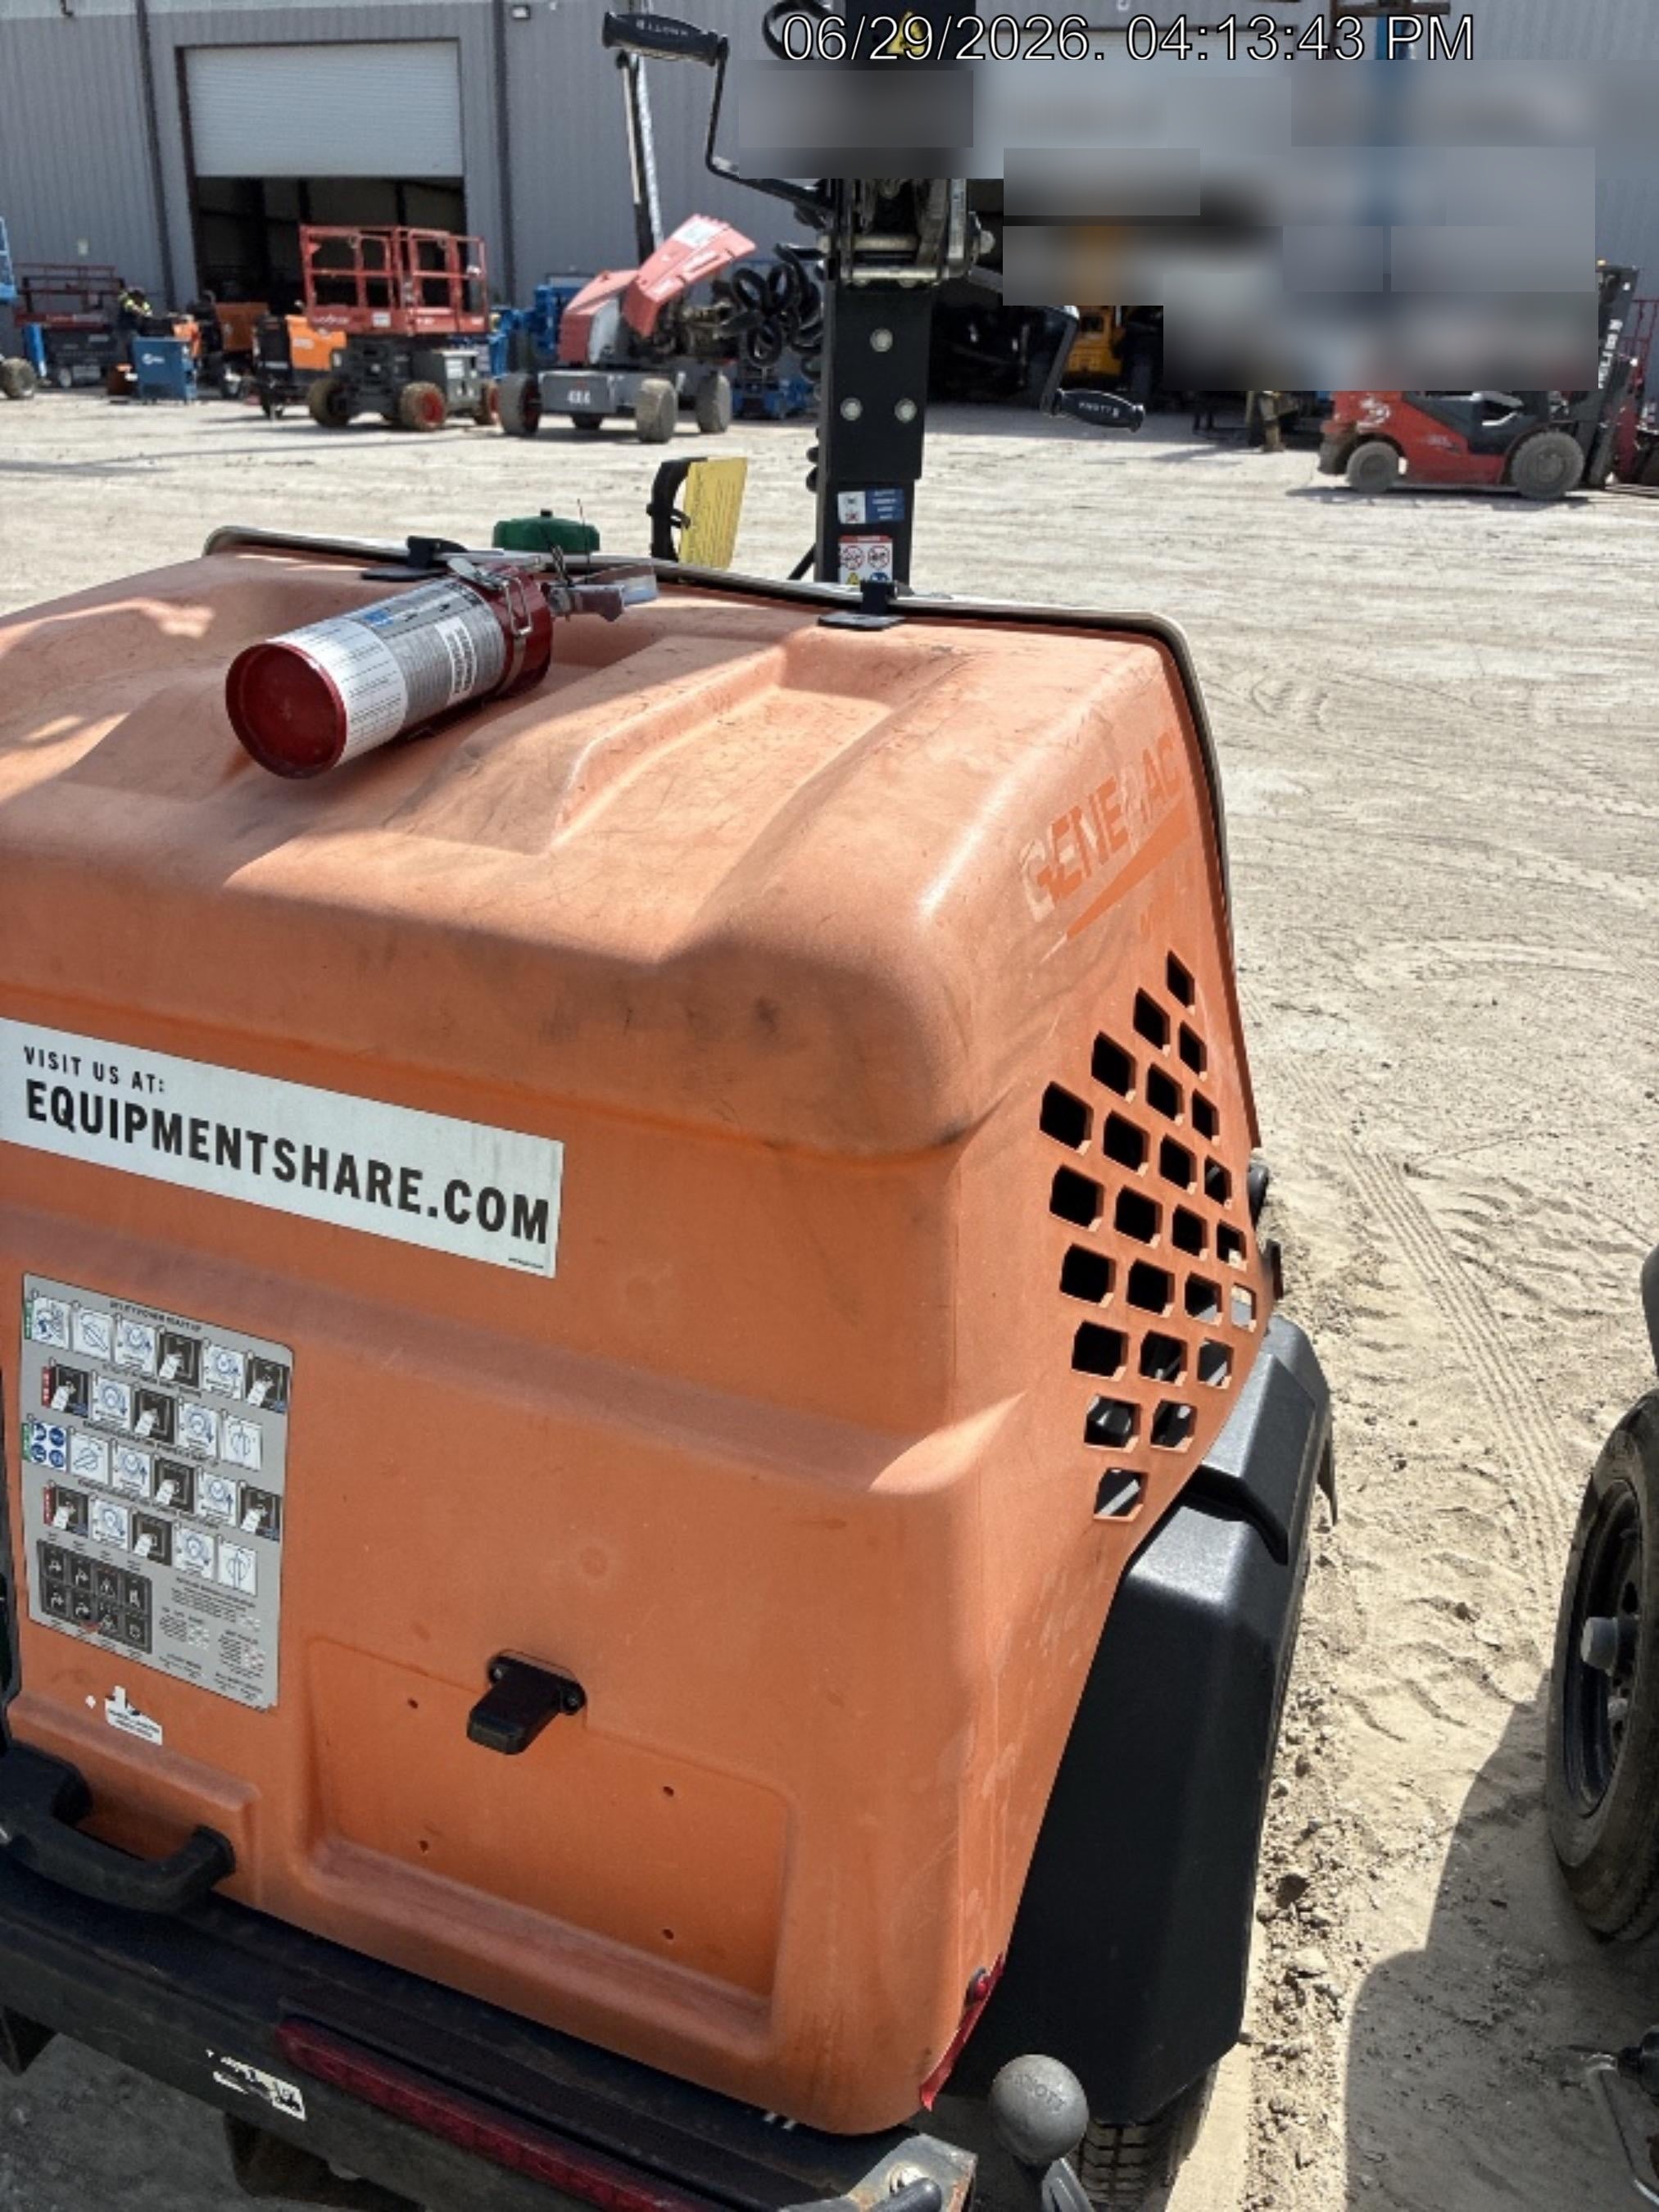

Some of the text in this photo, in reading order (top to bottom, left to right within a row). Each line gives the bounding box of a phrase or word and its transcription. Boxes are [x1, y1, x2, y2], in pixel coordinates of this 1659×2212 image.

[24, 1045, 165, 1094] VISIT US AT:
[25, 1078, 549, 1244] EQUIPMENTSHARE.COM
